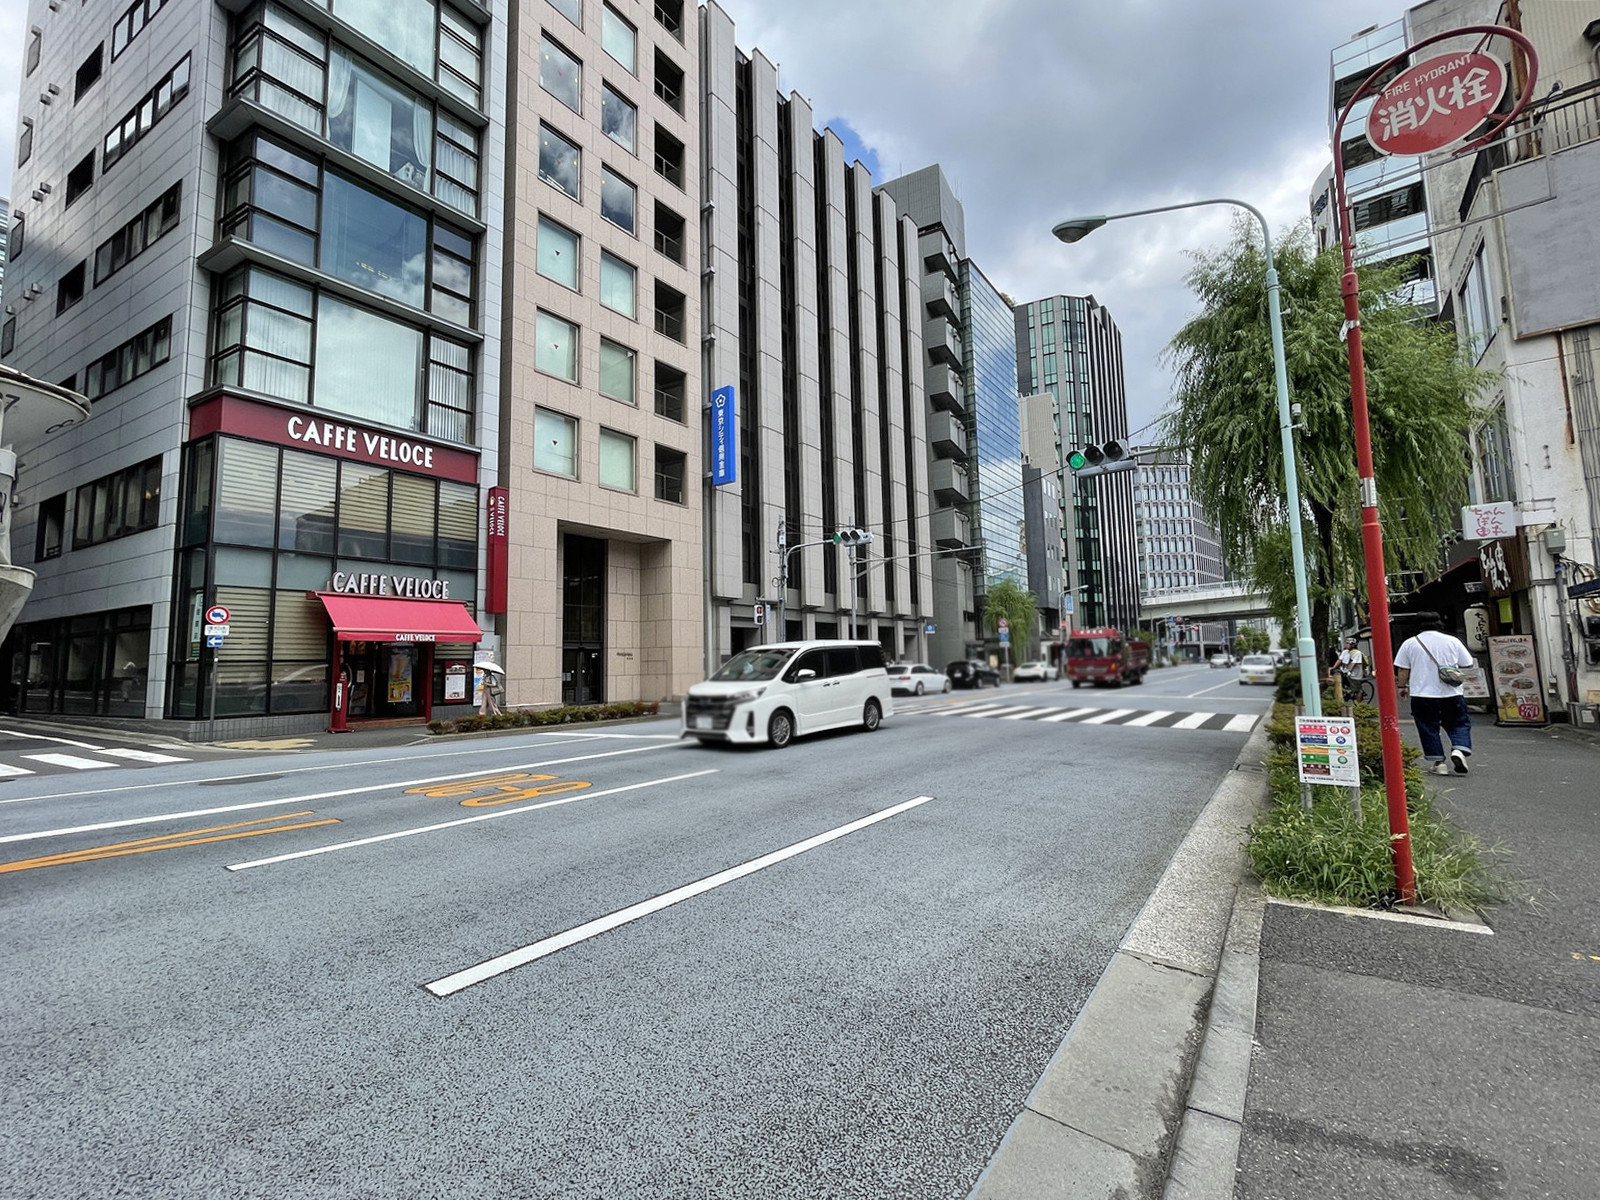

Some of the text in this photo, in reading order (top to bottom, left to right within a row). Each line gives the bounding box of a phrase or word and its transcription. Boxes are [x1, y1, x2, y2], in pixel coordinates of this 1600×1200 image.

[1384, 55, 1472, 100] FIRE HYDRANT
[1377, 67, 1493, 142] 消火栓
[362, 432, 433, 468] VELOCE
[1471, 506, 1506, 519] ちゃん
[392, 575, 449, 600] VELOCE
[414, 633, 436, 642] VELOCE
